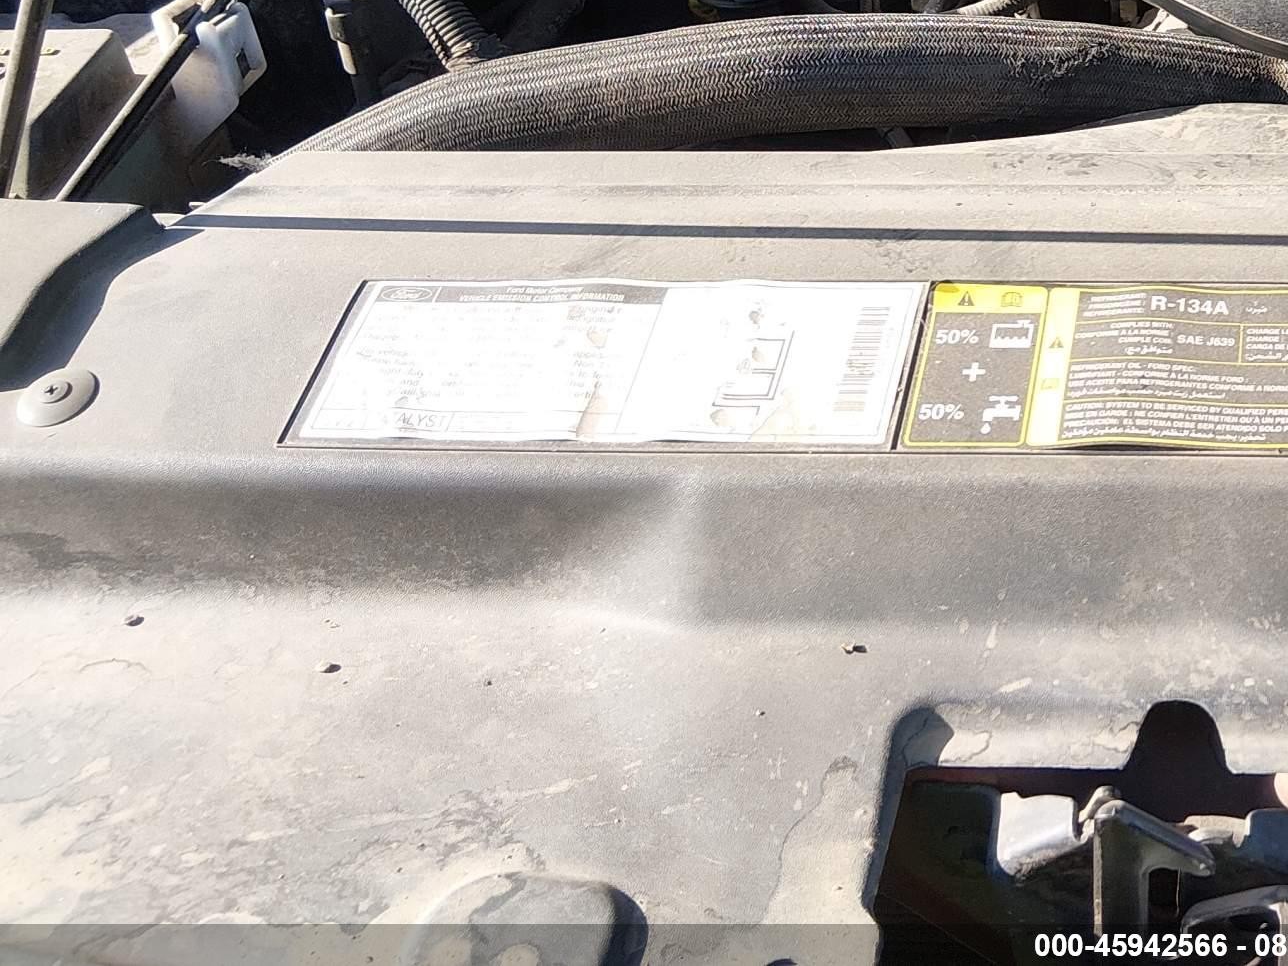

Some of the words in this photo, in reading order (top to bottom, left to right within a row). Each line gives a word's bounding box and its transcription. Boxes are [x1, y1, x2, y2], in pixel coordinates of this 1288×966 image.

[391, 287, 422, 300] Ford
[570, 293, 624, 301] INFORMATION
[1151, 296, 1229, 315] R-134A
[936, 329, 979, 344] 50%
[1177, 335, 1203, 345] SAE
[1207, 338, 1235, 346] J639
[1140, 379, 1207, 390] REFRIGERANTES
[1209, 383, 1256, 391] CONFORME
[919, 404, 964, 420] 50%
[1167, 404, 1208, 412] SERVICED
[1148, 412, 1185, 420] CONFIER
[1186, 414, 1239, 422] L'ENTRETIEN
[1136, 419, 1172, 427] SISTEMA
[1216, 424, 1257, 432] ATENDIDO
